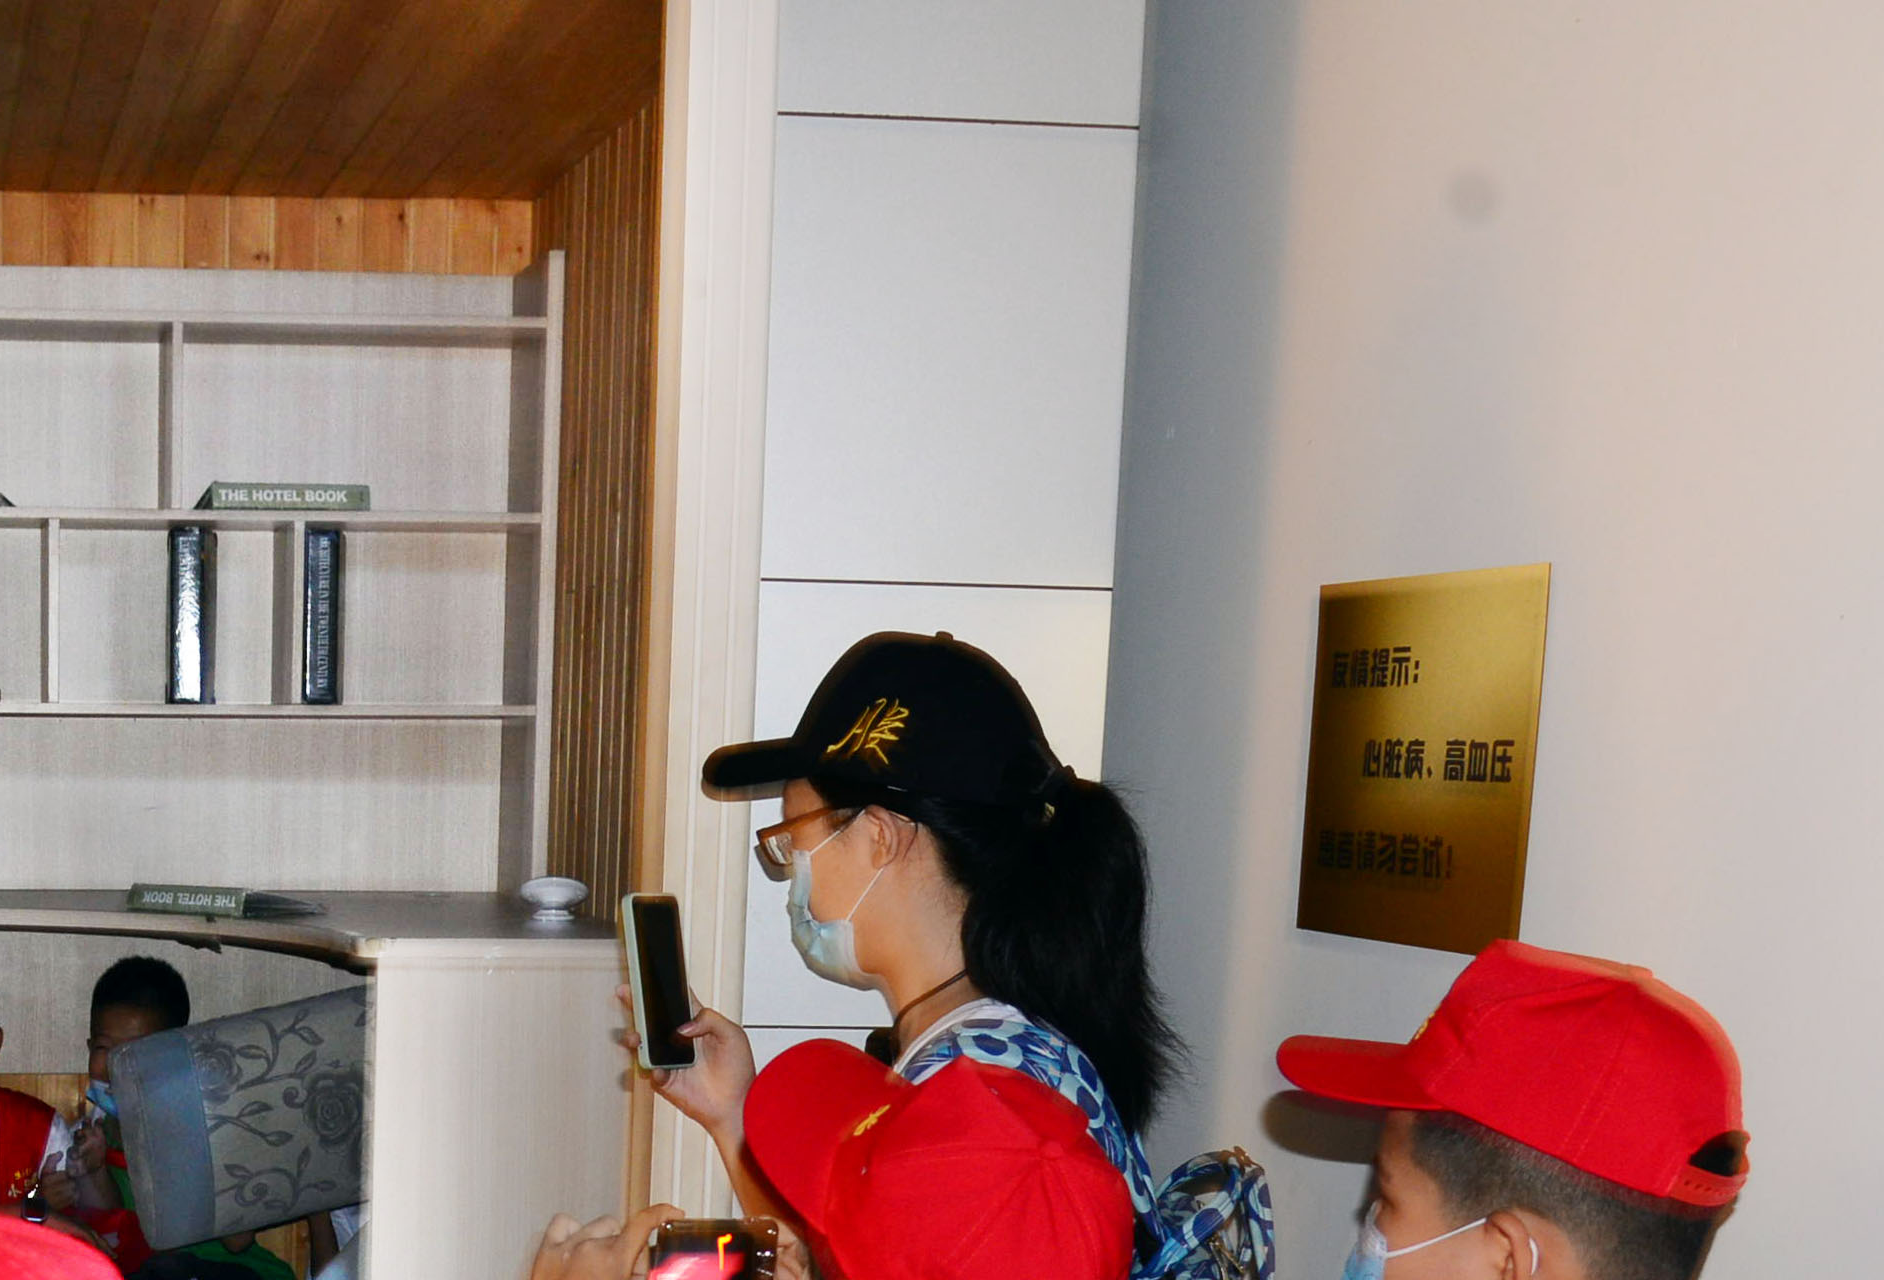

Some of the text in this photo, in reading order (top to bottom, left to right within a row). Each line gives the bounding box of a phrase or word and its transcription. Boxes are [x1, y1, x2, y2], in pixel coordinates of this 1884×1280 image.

[219, 489, 348, 503] THE HOTEL BOOK
[1362, 738, 1515, 784] 心脏病、高血压
[143, 890, 236, 908] THE HOTEL BOOK
